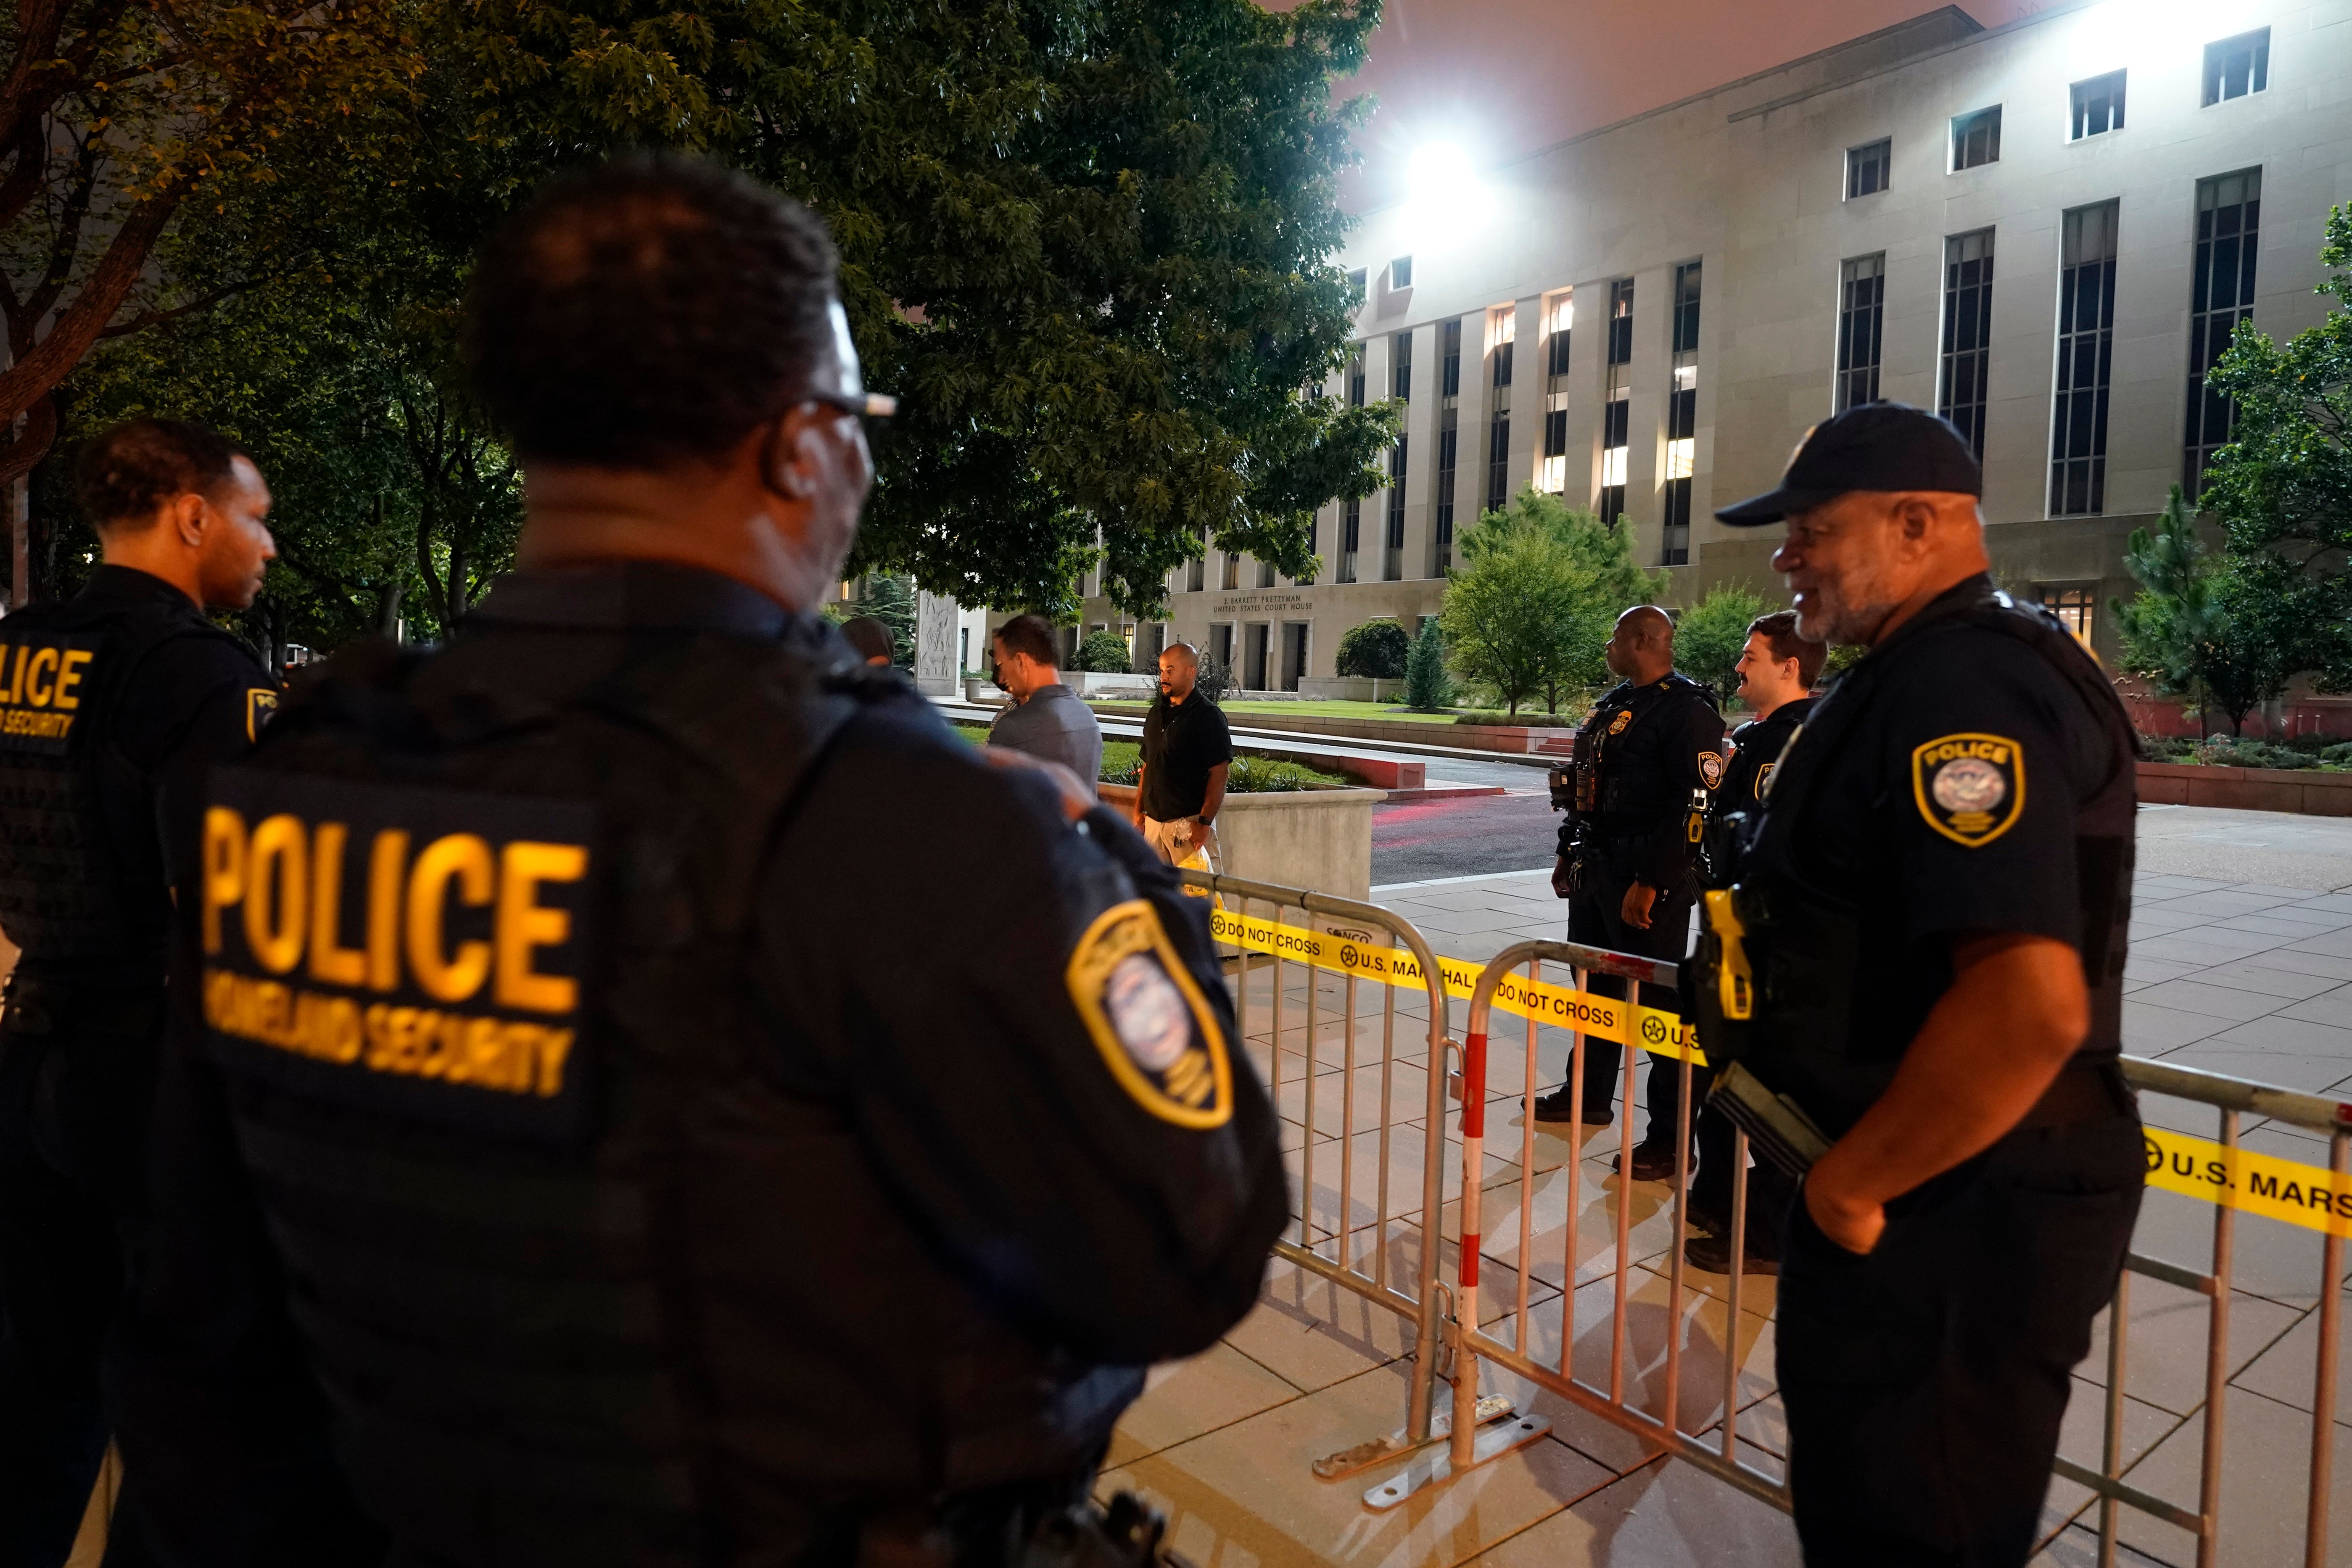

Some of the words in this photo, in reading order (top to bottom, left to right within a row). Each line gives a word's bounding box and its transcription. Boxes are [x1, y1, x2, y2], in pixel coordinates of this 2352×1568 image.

[1261, 594, 1301, 603] PRETTYMAN
[1701, 754, 1721, 764] POLICE
[1924, 742, 2009, 767] POLICE
[202, 804, 589, 1014] POLICE
[1228, 923, 1244, 937] DO
[1249, 927, 1272, 944] NOT
[1276, 934, 1320, 956] CROSS
[1362, 953, 1386, 972] U.S.
[1498, 982, 1515, 1000] DO
[1518, 989, 1549, 1010] NOT
[1554, 999, 1613, 1027] CROSS
[2172, 1153, 2235, 1189] U.S.
